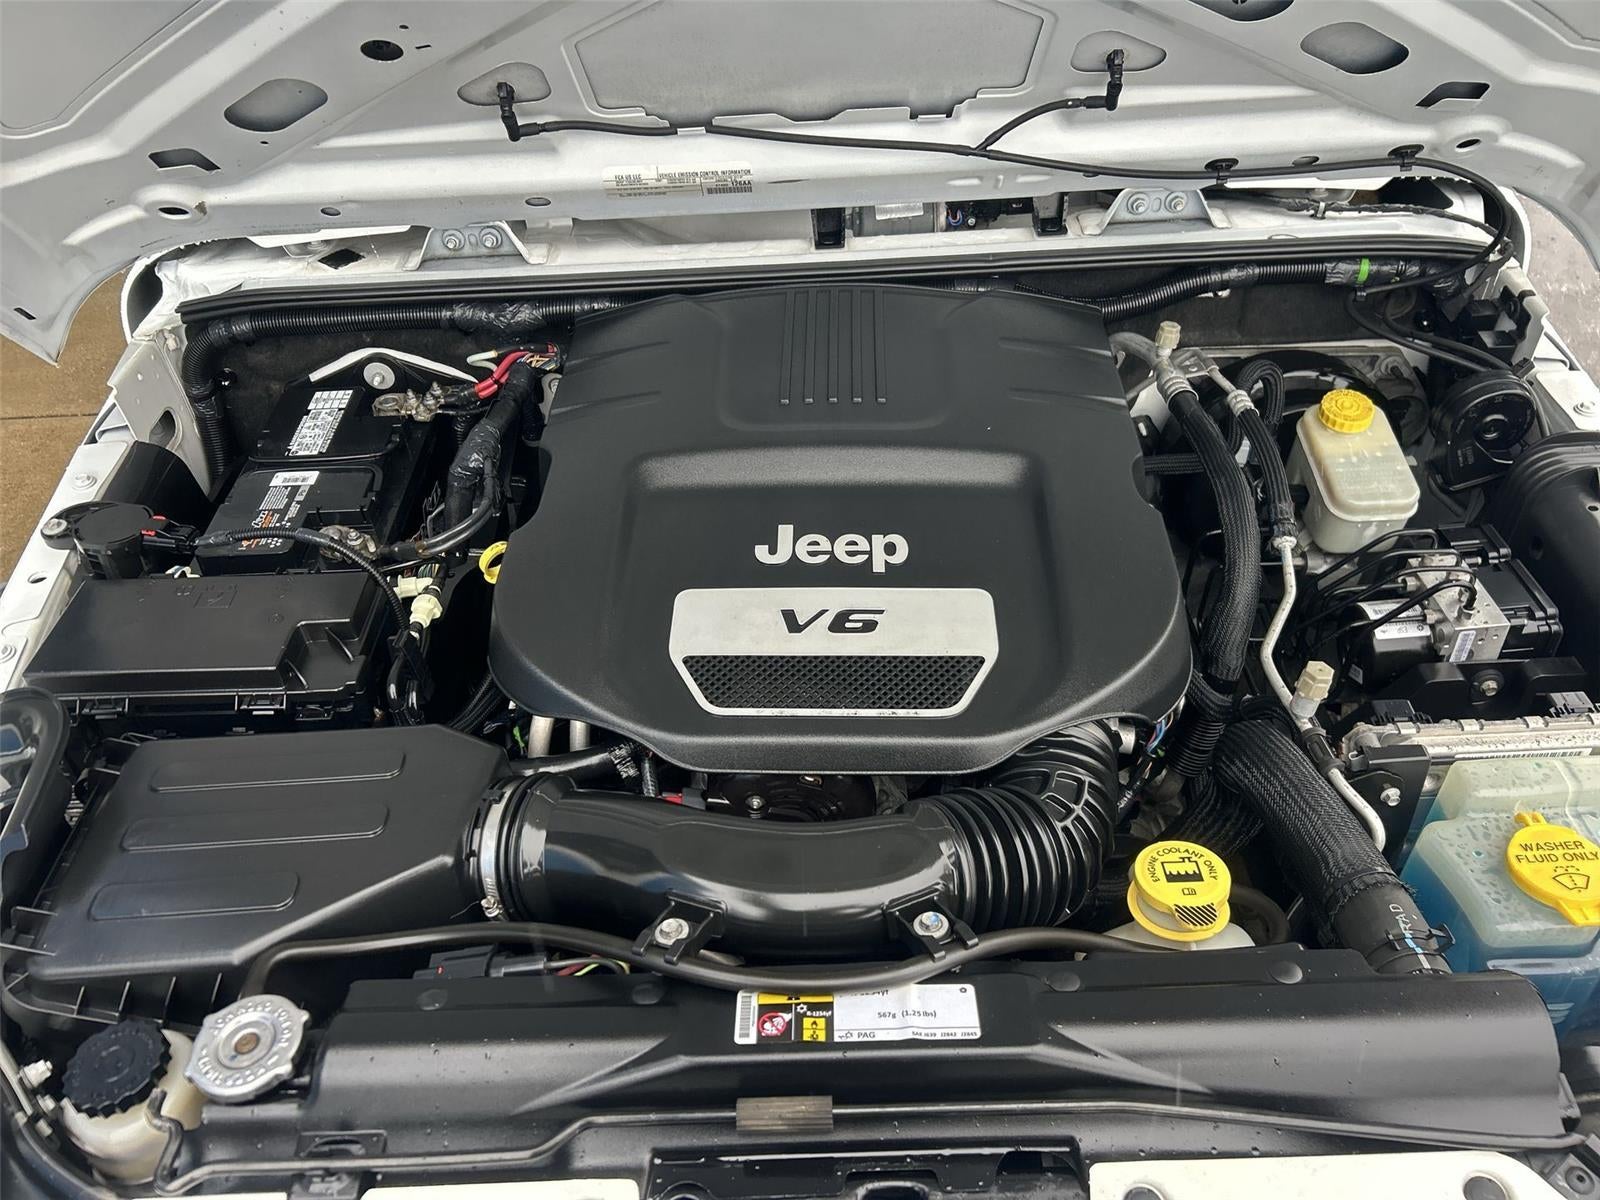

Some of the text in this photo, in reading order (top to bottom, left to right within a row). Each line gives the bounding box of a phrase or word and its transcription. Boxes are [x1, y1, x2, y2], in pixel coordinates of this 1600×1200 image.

[754, 523, 909, 574] Jeep
[779, 608, 886, 635] V6
[1519, 840, 1586, 852] WASHER
[1515, 851, 1600, 864] FLUID ONLY
[1147, 847, 1218, 882] ENGINE COOLANT ONLY
[877, 1009, 937, 1020] 567g (1.25 lbs)
[857, 1031, 876, 1039] PAG
